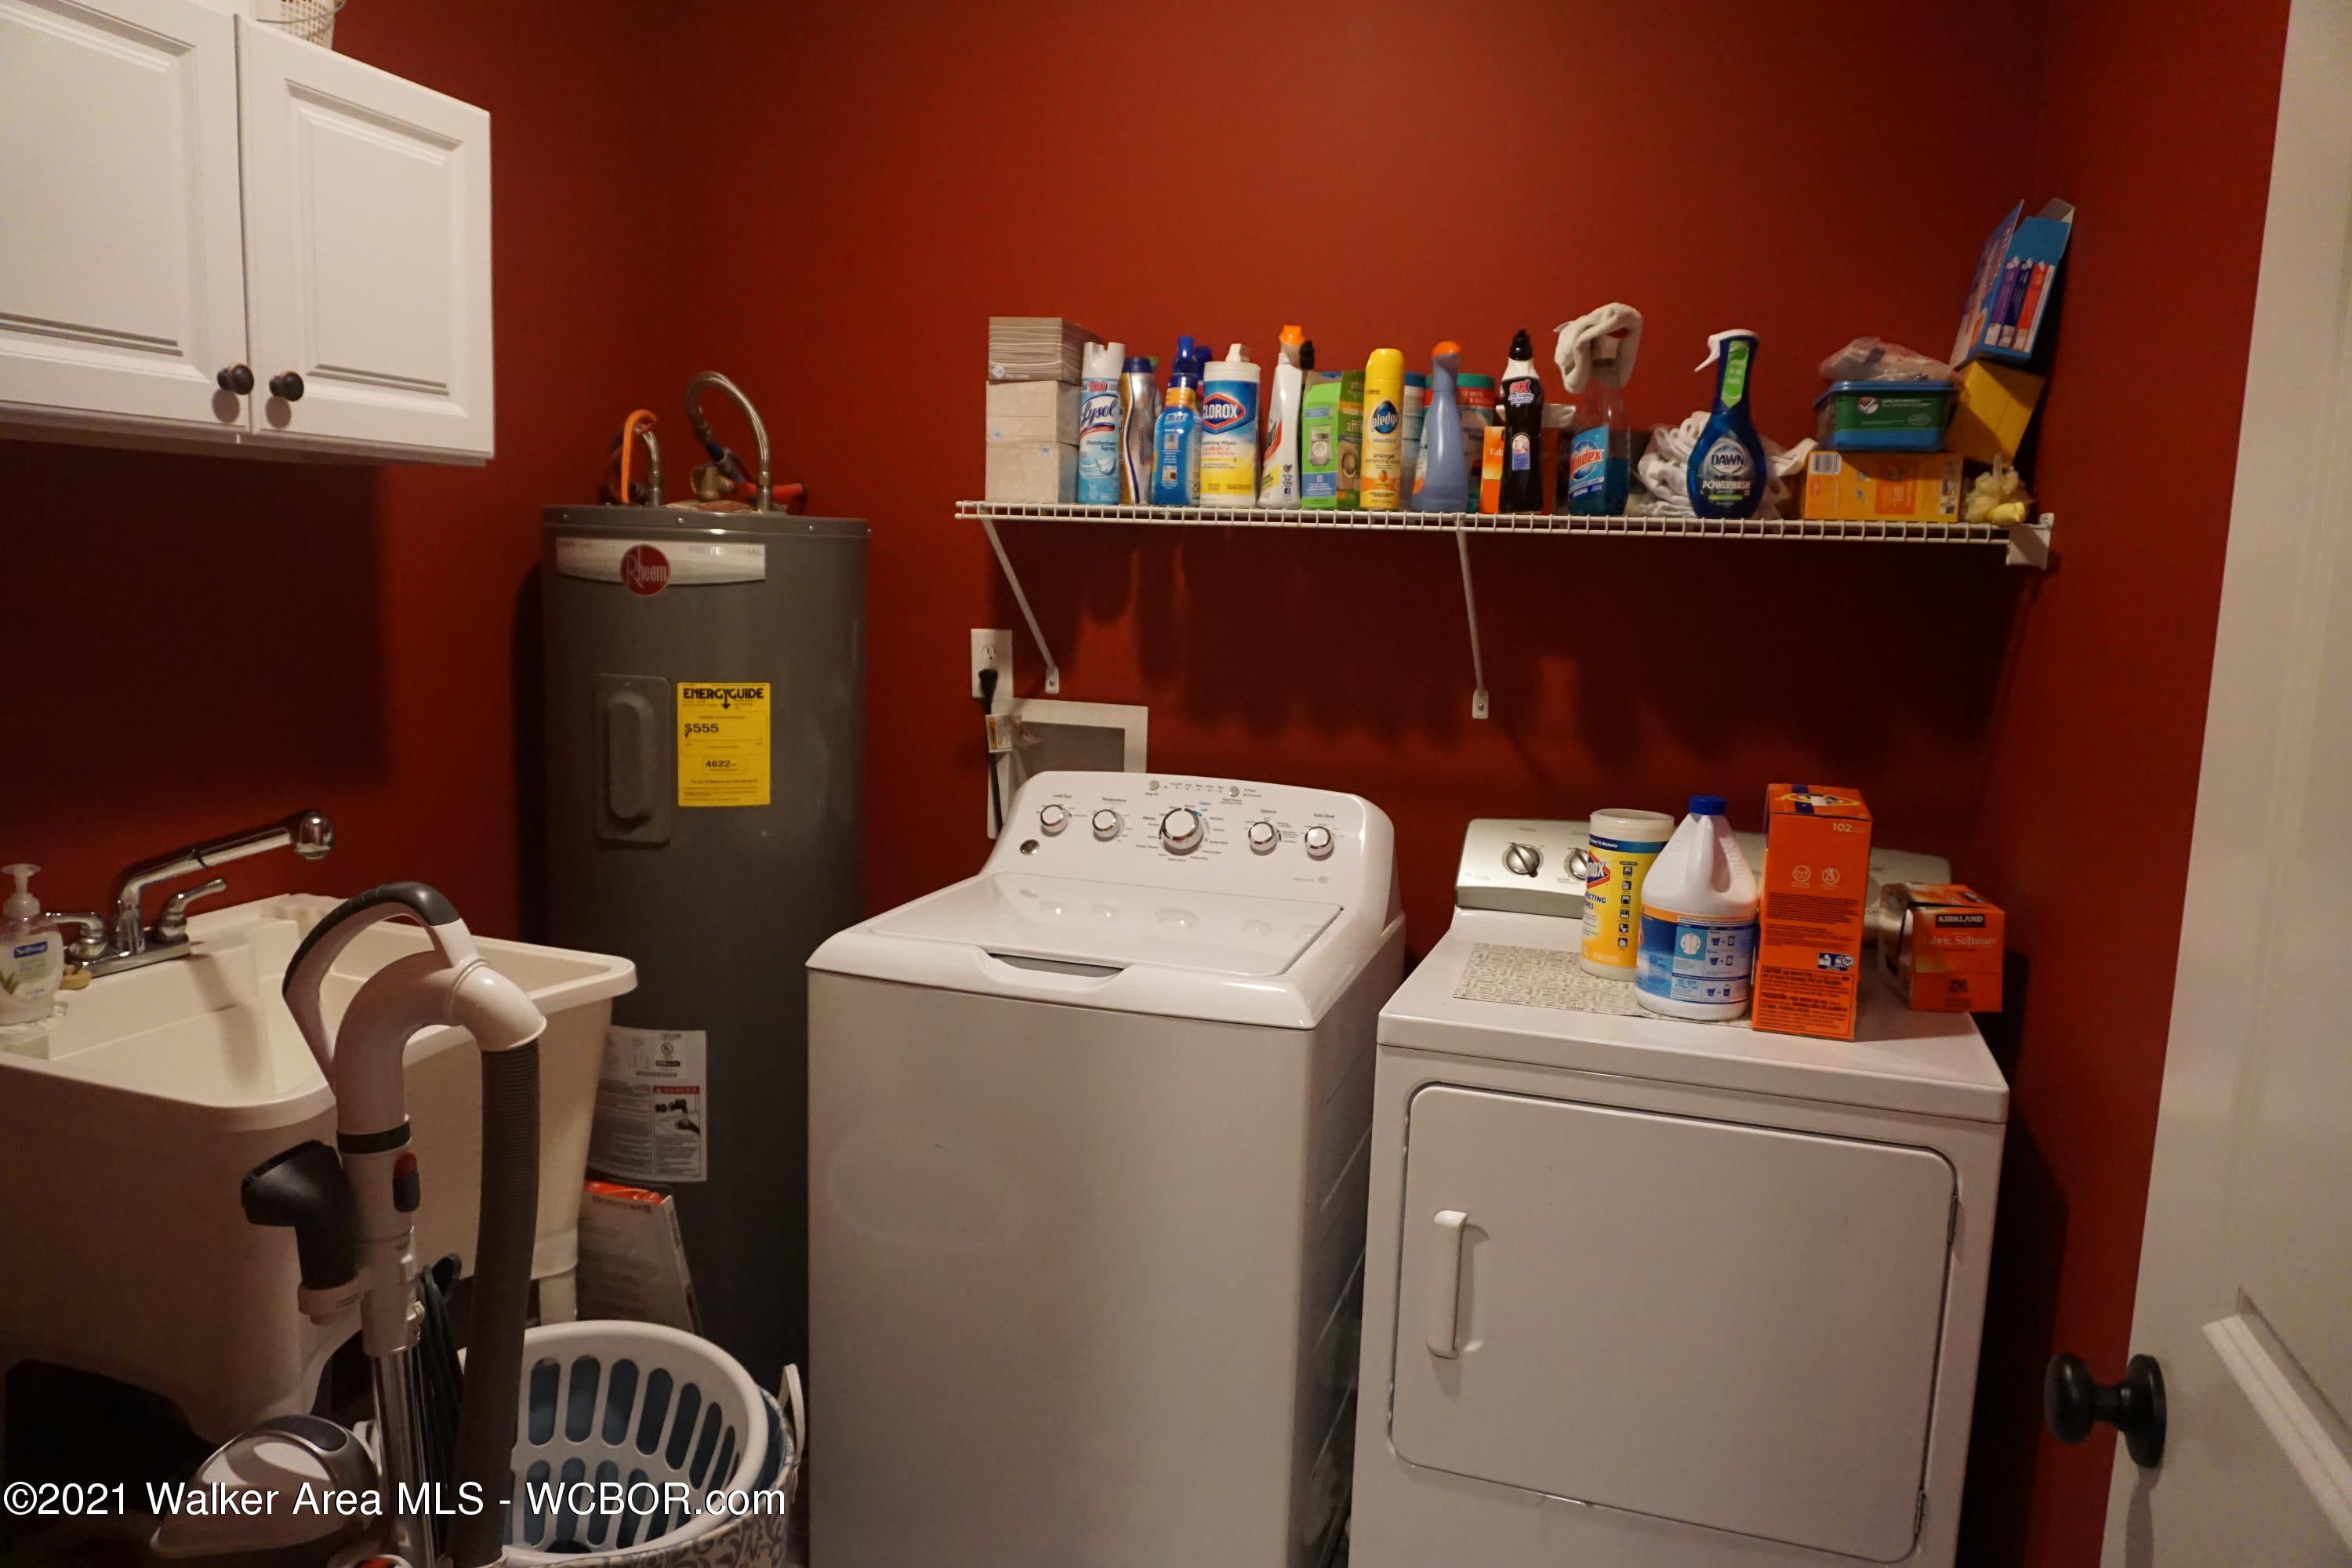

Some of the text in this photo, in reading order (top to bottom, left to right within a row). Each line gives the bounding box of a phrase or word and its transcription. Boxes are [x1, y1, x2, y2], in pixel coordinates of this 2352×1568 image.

[1081, 398, 1116, 427] Lysol
[1711, 454, 1744, 466] DAWN
[1702, 481, 1750, 489] POWERWASH
[626, 546, 666, 587] Rheem
[683, 688, 764, 699] ENERGYGUIDE
[684, 723, 719, 734] $555
[1832, 823, 1852, 832] 102
